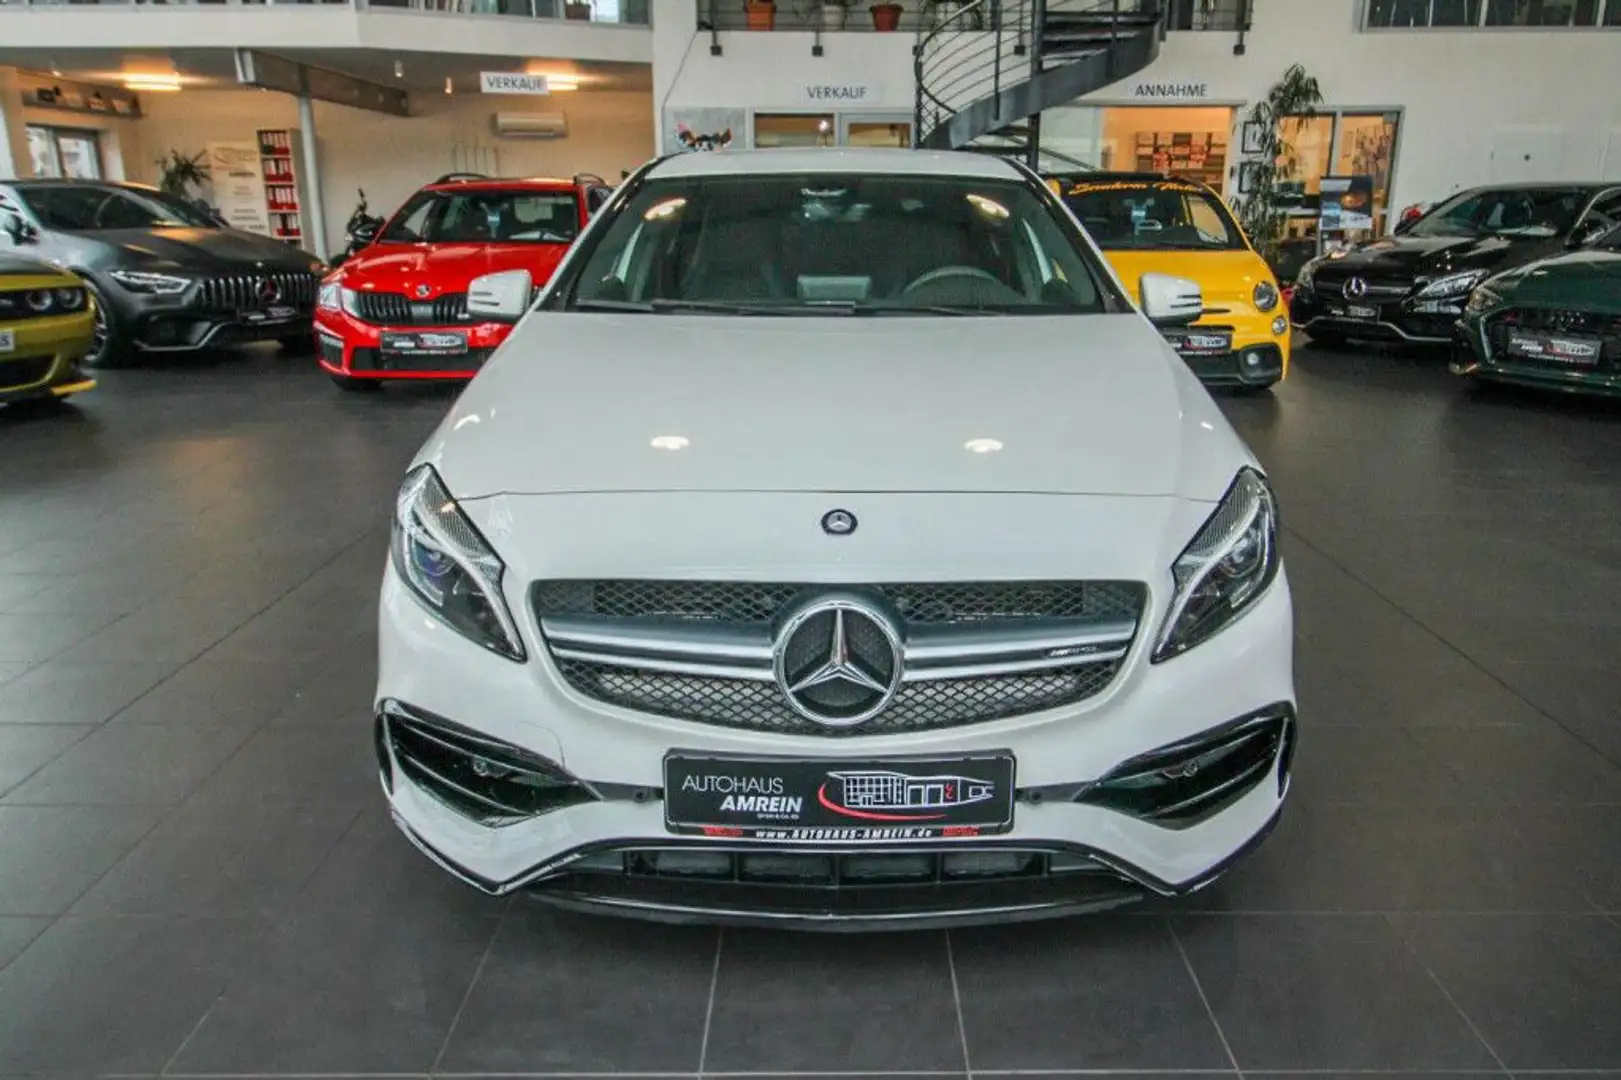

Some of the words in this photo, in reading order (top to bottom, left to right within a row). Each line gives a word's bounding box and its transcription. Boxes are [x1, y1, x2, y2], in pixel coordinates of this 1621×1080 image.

[806, 86, 867, 99] VERKAUF
[1135, 84, 1208, 96] ANNAHME
[682, 774, 784, 794] AUTOHAUS
[720, 795, 803, 812] AMREIN
